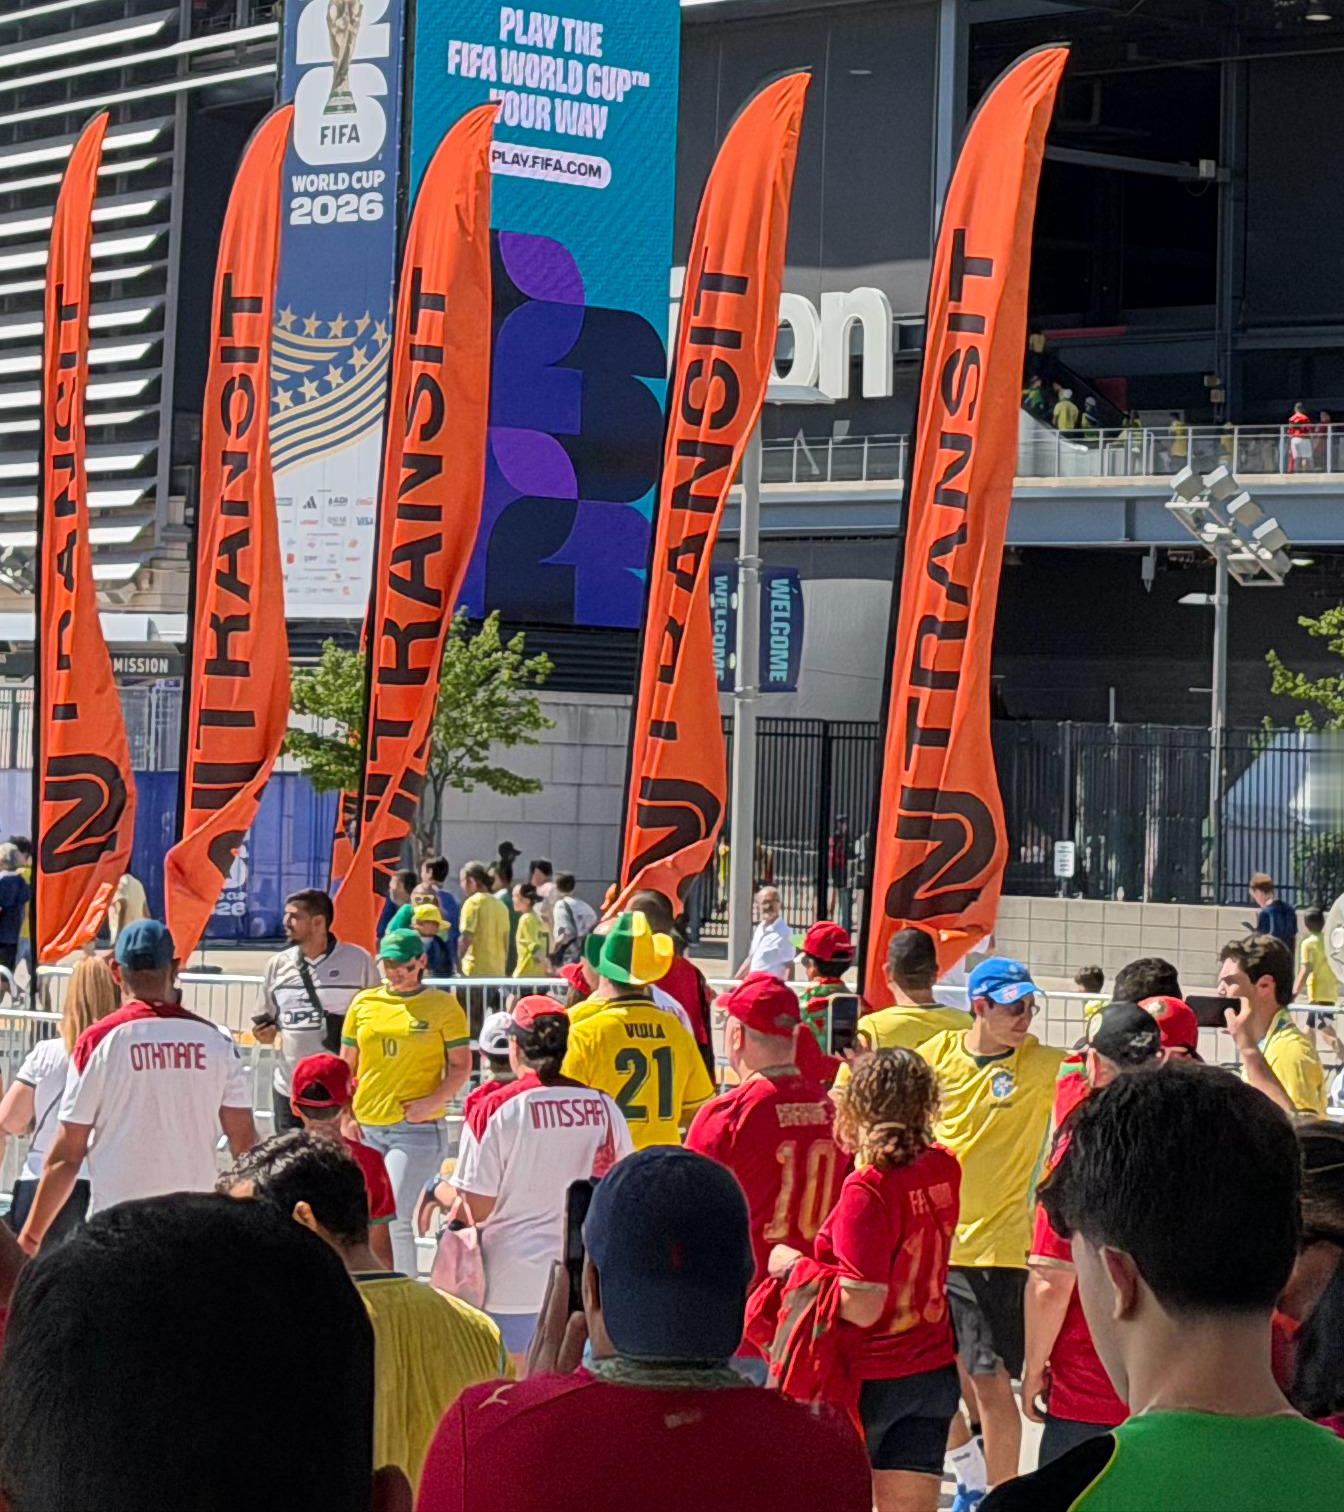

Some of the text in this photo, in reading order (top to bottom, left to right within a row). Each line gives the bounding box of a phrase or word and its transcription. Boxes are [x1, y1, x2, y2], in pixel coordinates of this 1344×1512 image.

[499, 7, 604, 58] PLAY THE
[447, 40, 498, 82] FIFA
[501, 49, 583, 94] WORLD
[319, 124, 360, 146] FIFA
[489, 88, 608, 139] YOUR WAY
[292, 170, 386, 194] WORLD CUP
[491, 150, 602, 179] PLAY.FIFA.COM
[290, 193, 384, 225] 2026
[195, 273, 263, 751] TRANSIT
[369, 266, 447, 763] TRANSIT
[905, 229, 993, 772] TRANSIT
[769, 578, 791, 682] WELCOME
[113, 657, 168, 673] MISSION
[215, 902, 246, 916] 26
[382, 1038, 399, 1057] 10
[625, 1023, 666, 1039] VIOLA
[615, 1046, 673, 1121] 21
[763, 1140, 836, 1243] 10
